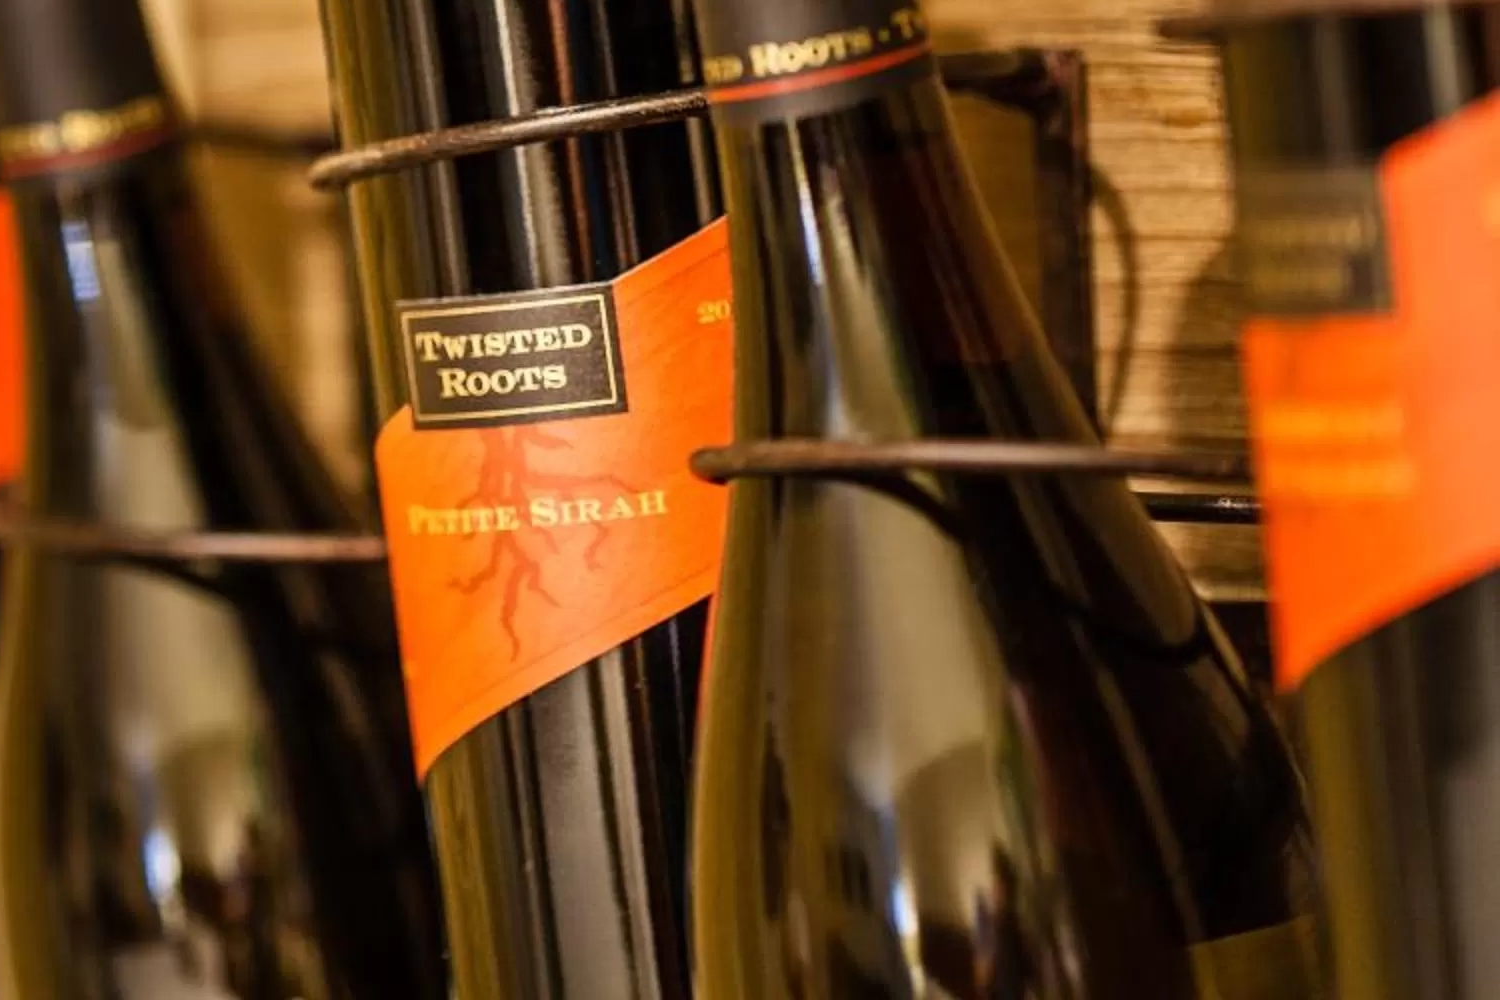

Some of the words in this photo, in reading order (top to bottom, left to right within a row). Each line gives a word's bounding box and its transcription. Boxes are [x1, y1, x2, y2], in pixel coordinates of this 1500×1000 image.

[749, 26, 872, 78] ROOTS
[415, 322, 593, 362] TWISTED
[437, 363, 569, 399] ROOTS
[406, 505, 520, 537] PETITE
[530, 490, 670, 530] SIRAH
